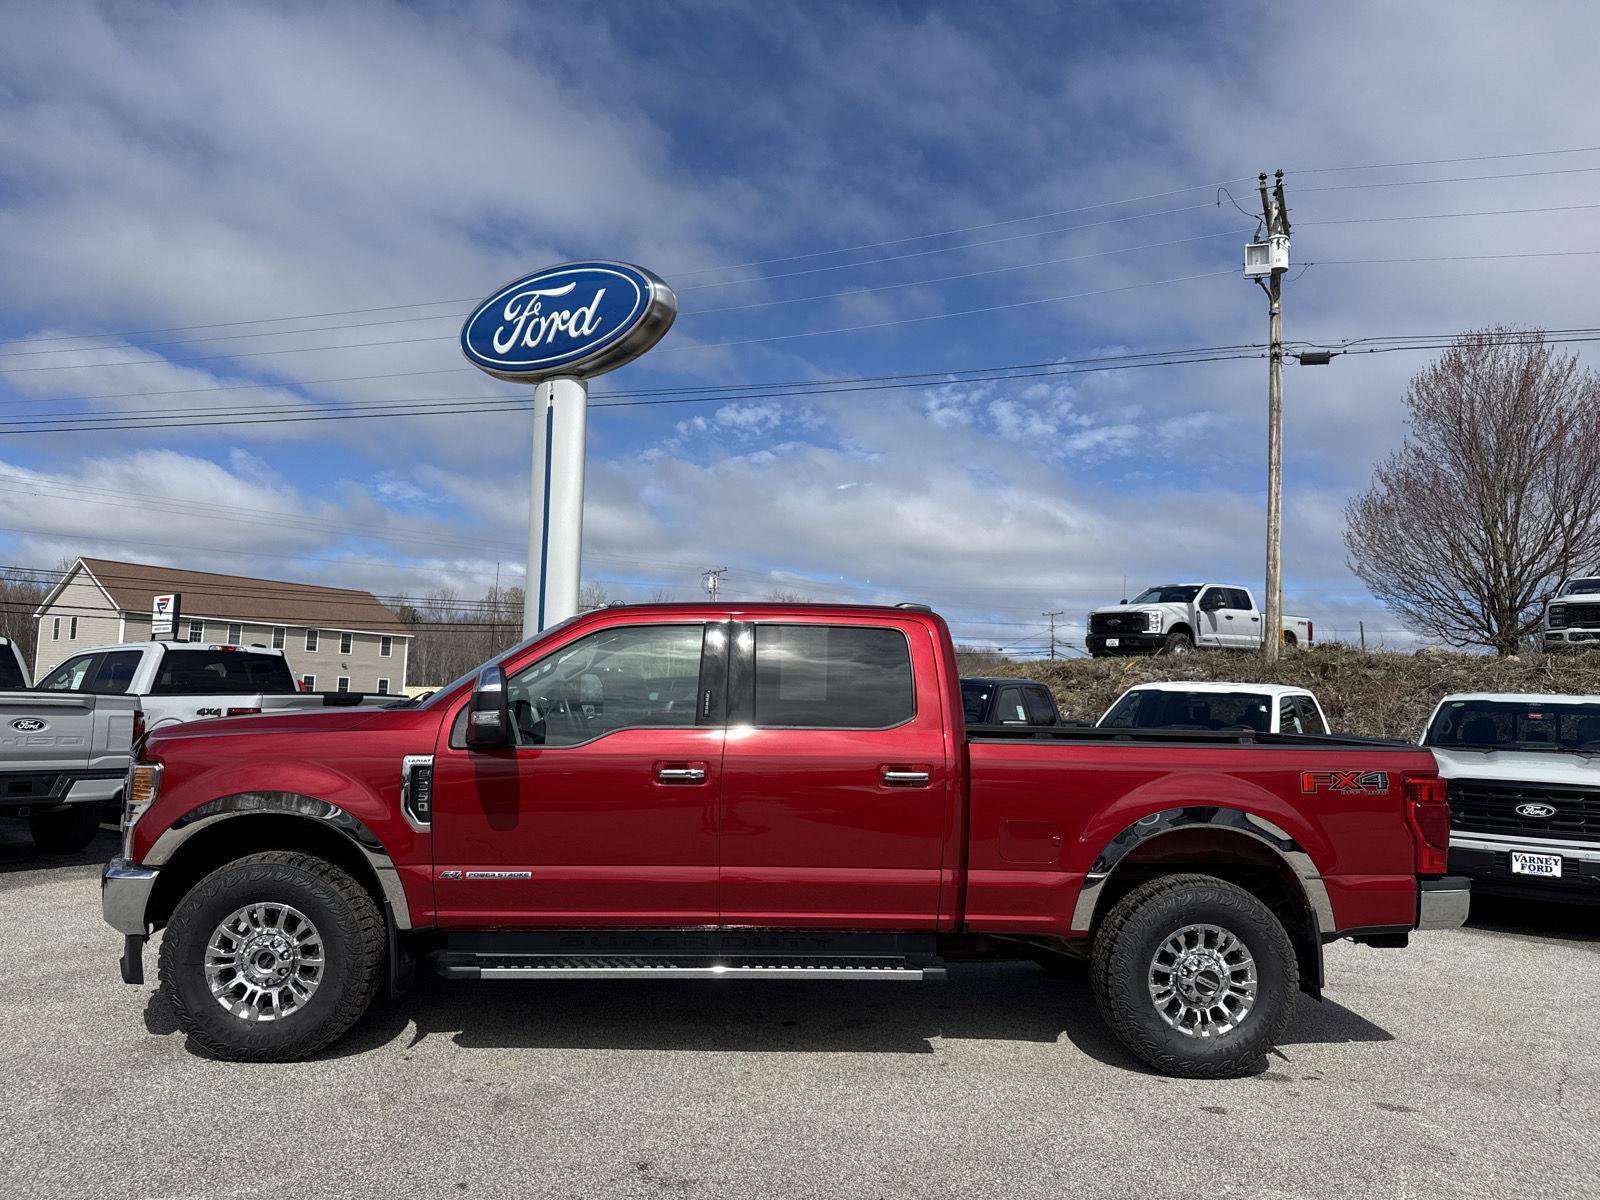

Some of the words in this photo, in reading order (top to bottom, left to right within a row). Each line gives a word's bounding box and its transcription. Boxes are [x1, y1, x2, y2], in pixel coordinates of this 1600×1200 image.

[493, 282, 606, 354] Ford
[18, 720, 40, 729] Ford
[1301, 771, 1389, 794] FX4
[1523, 806, 1547, 815] Ford
[1514, 854, 1560, 866] VARNEY
[1520, 863, 1553, 873] FORD
